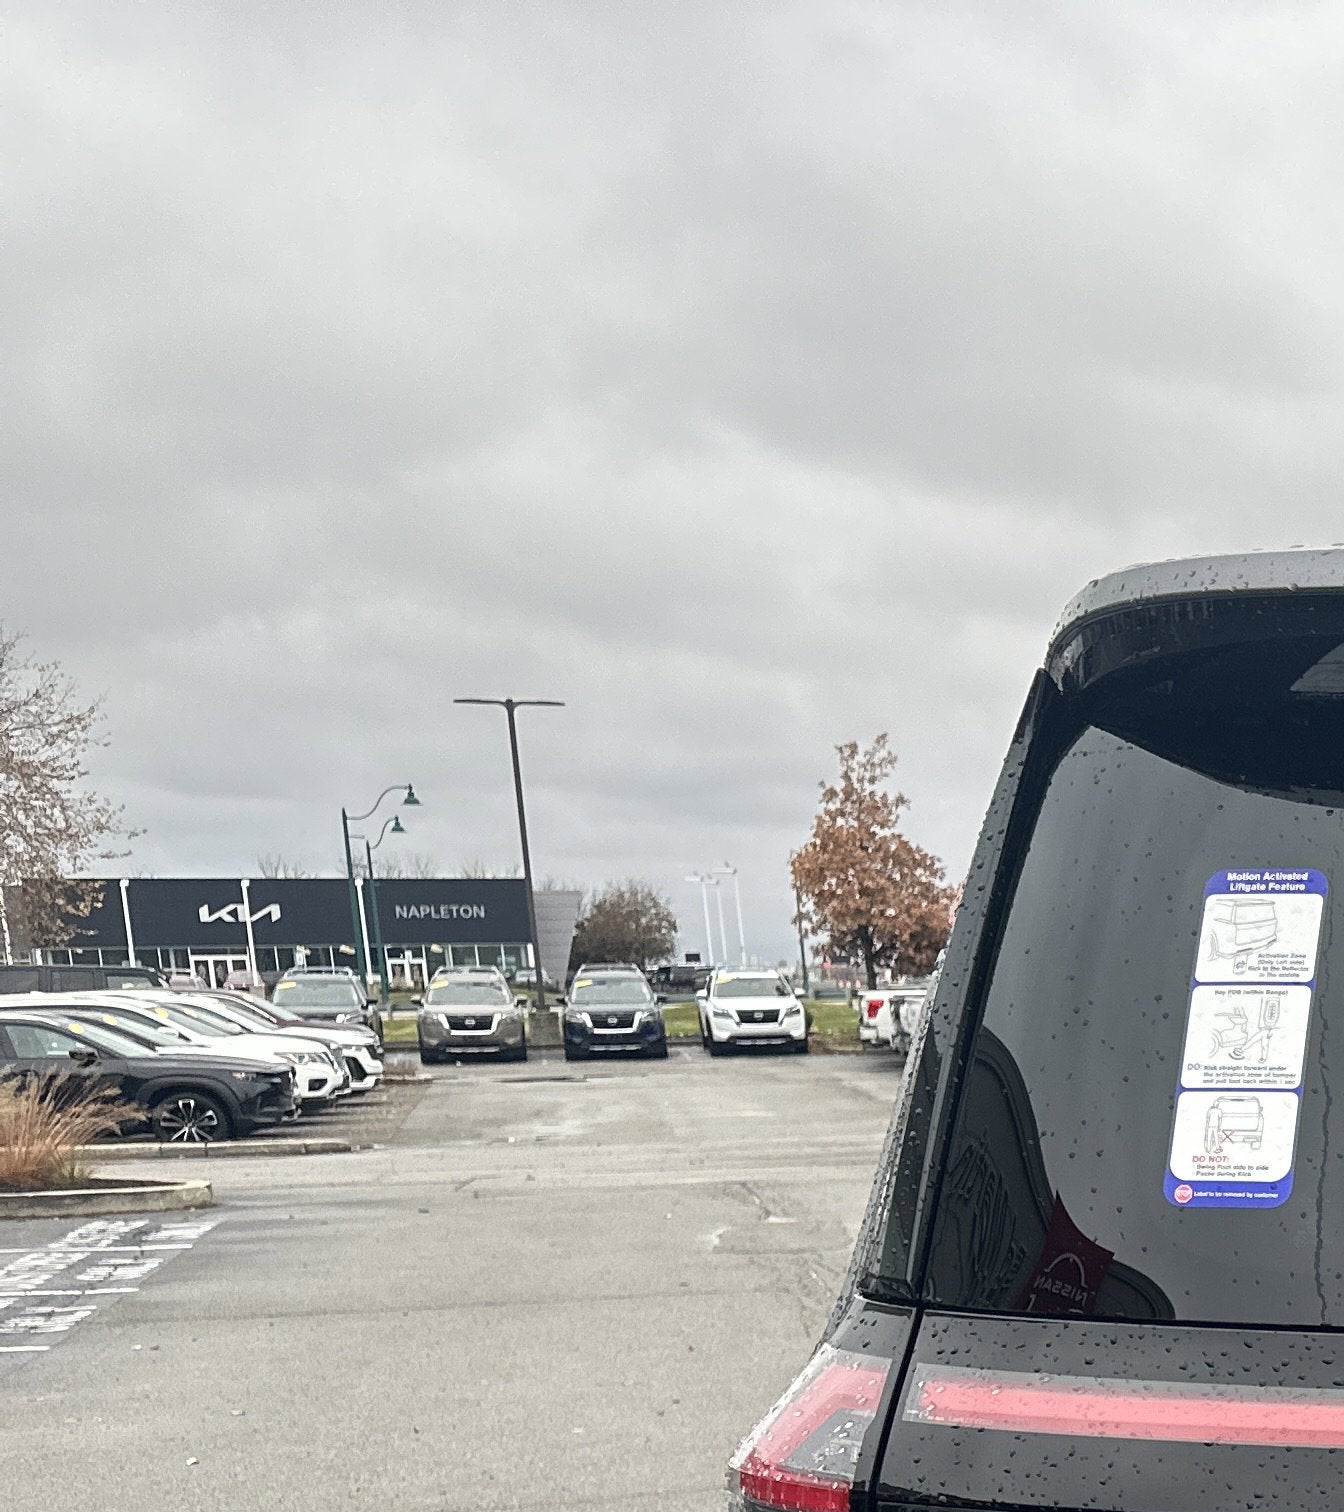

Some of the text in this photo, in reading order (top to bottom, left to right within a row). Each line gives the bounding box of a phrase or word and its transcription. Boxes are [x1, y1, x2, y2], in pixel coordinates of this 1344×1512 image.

[1227, 872, 1309, 881] Motion Activated
[1230, 883, 1306, 892] Liftgate Feature
[395, 904, 485, 919] NAPLETON
